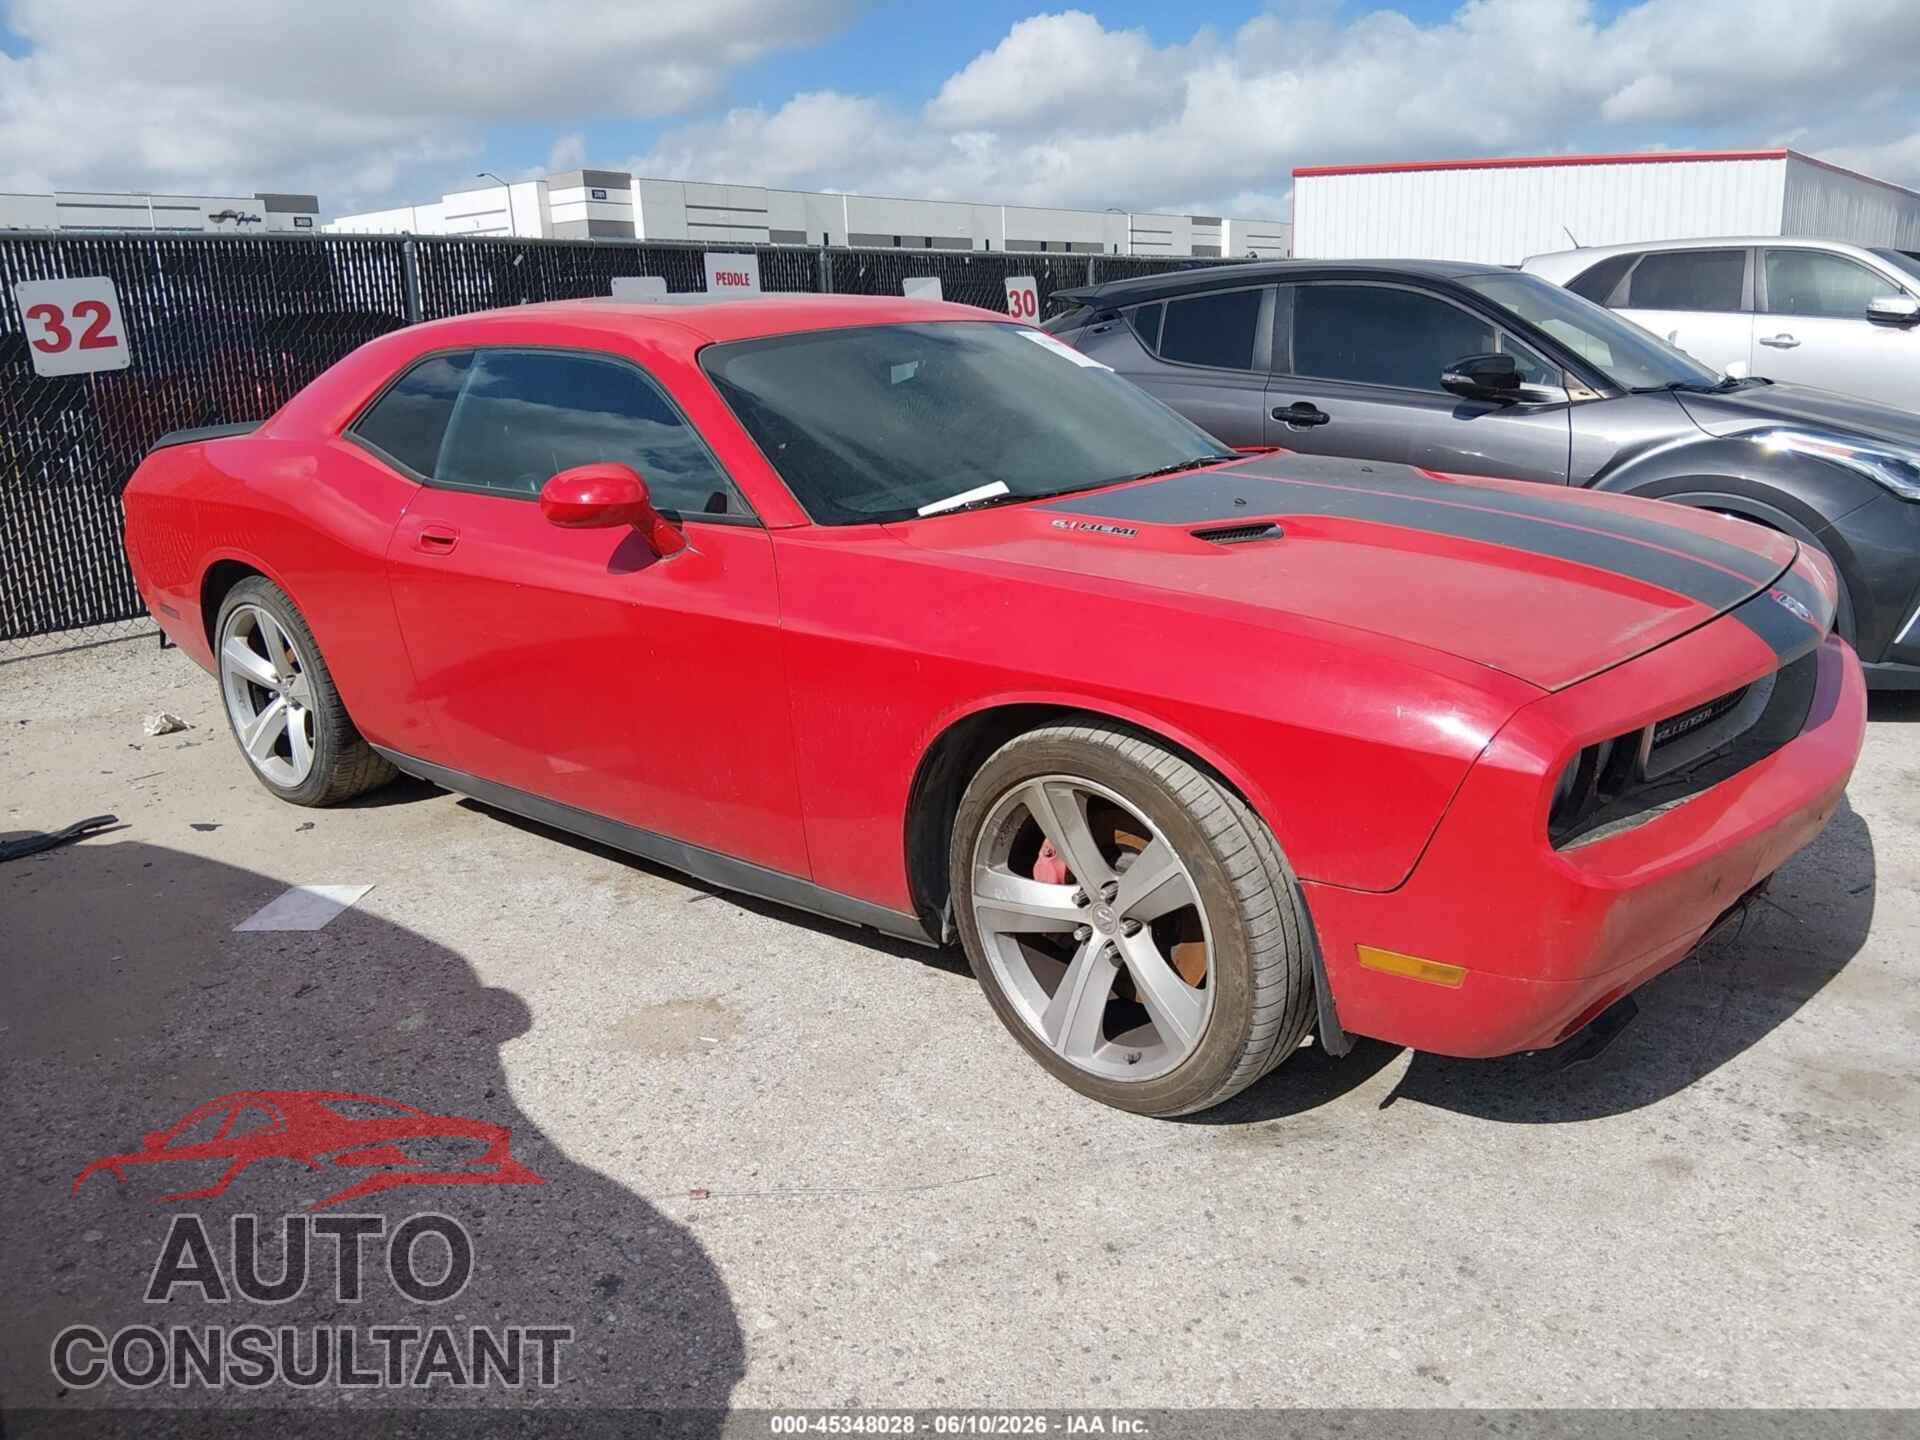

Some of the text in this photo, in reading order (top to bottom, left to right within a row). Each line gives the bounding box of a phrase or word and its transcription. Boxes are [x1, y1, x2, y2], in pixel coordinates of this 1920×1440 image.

[715, 271, 751, 287] PEDDLE
[1008, 289, 1036, 318] 30
[26, 300, 118, 353] 32
